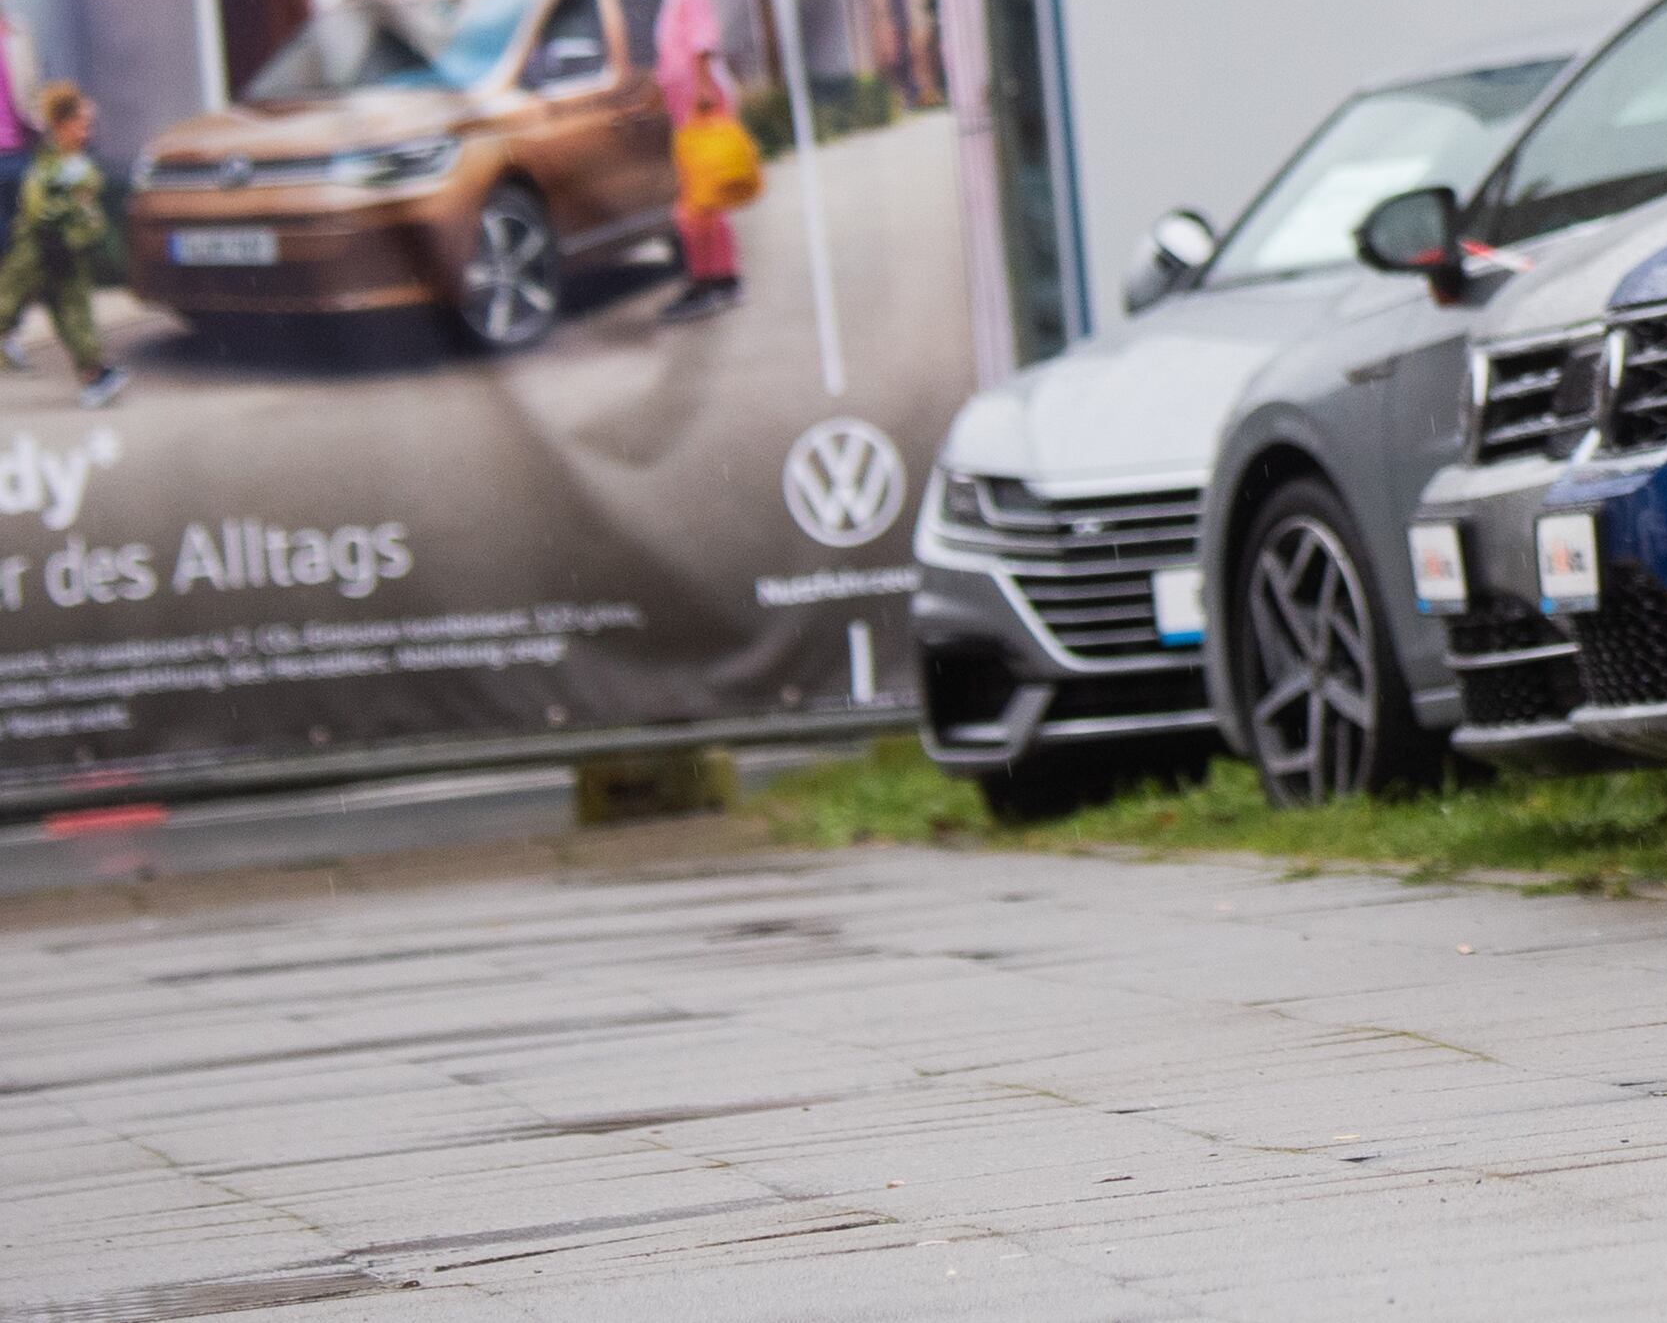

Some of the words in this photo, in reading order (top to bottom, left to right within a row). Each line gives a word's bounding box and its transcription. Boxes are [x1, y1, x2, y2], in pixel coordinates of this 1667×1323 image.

[785, 422, 903, 543] VW
[44, 530, 158, 607] des
[172, 517, 413, 599] Alltags
